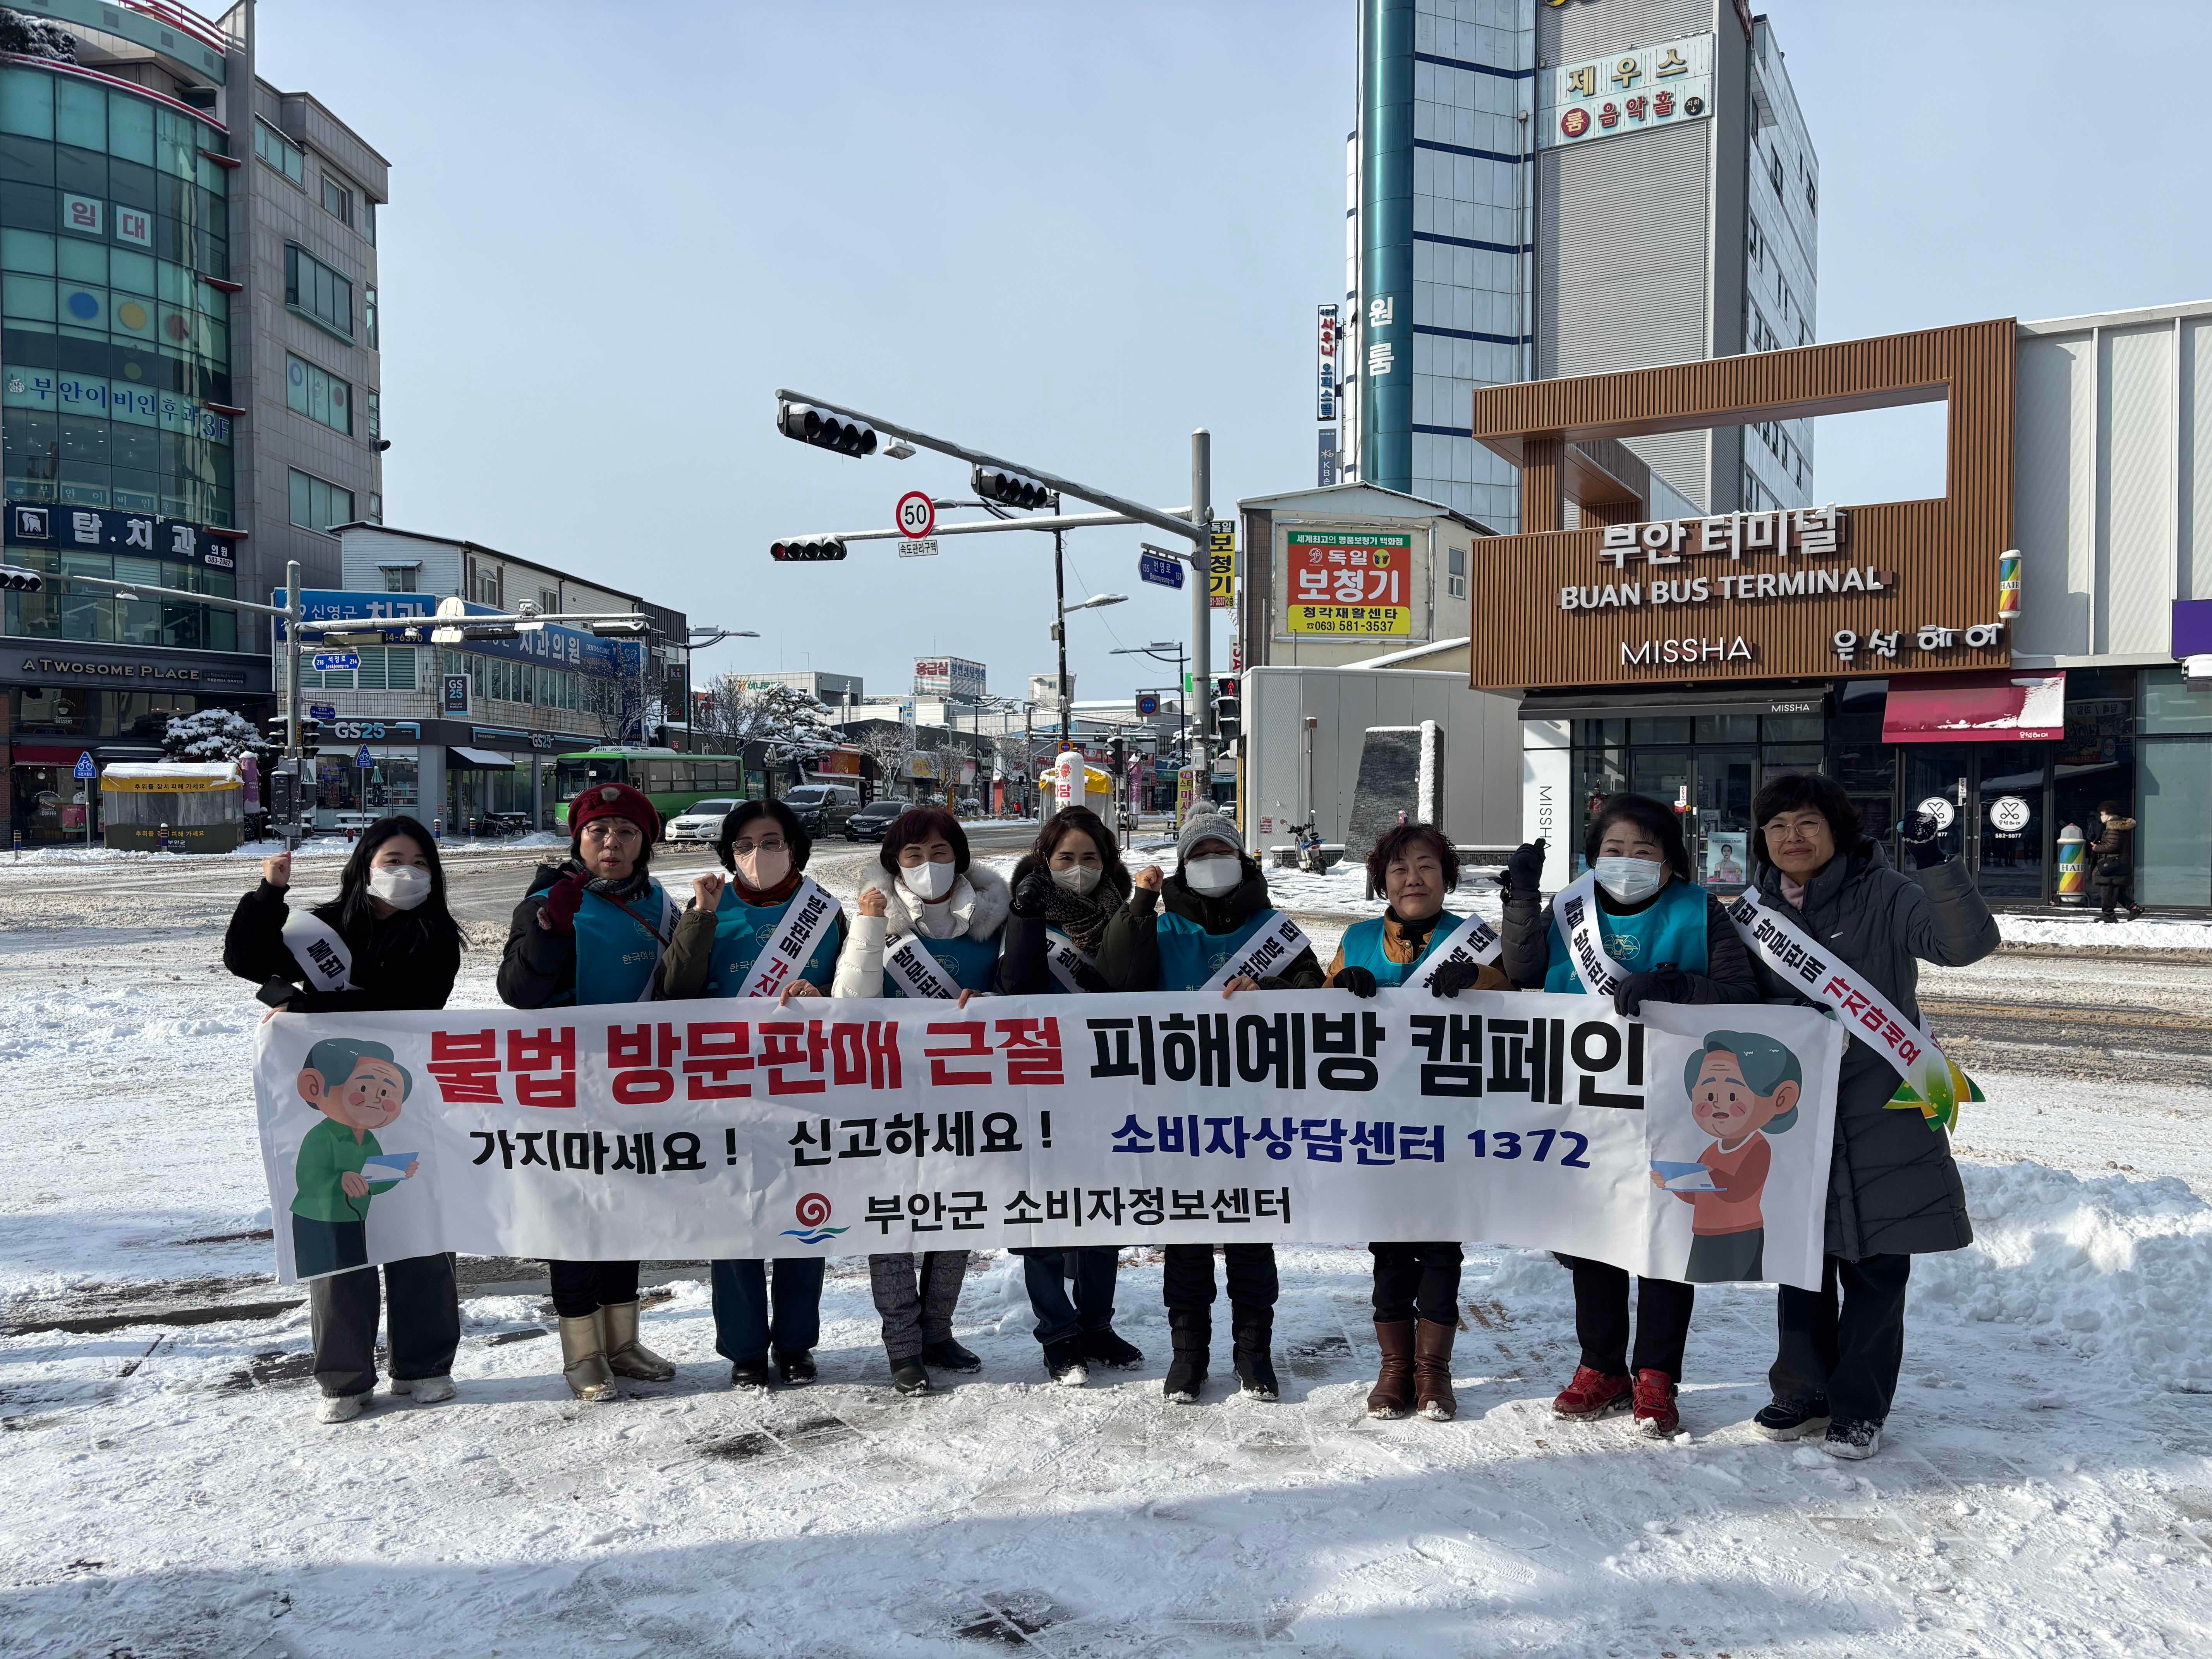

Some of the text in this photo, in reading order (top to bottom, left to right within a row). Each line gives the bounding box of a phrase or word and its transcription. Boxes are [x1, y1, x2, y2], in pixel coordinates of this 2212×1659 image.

[1567, 48, 1687, 97] 제우스
[1565, 111, 1586, 133] 룸
[1598, 91, 1674, 128] 음악홀
[71, 201, 145, 240] 임대
[1321, 318, 1334, 357] 사우나
[1368, 296, 1395, 376] 원룸
[1321, 363, 1333, 416] 오피스텔
[30, 377, 229, 440] 부안이비인후과 3F
[905, 505, 927, 526] 50
[1297, 534, 1403, 546] 세계최고의 명품보청기 백화점
[1599, 502, 1837, 568] 부안 터미널
[211, 544, 228, 557] 의원
[899, 541, 937, 556] 속도관리구역
[1328, 550, 1367, 566] 독일
[1153, 560, 1171, 574] 번영로
[1297, 568, 1398, 603] 보청기
[1561, 566, 1884, 610] BUAN BUS TERMINAL
[2001, 581, 2020, 590] HAIR
[1303, 606, 1398, 620] 청각재활센타
[1339, 620, 1393, 632] 581-3537
[328, 655, 346, 663] 석정로
[519, 629, 580, 665] 치과의원
[1621, 635, 1752, 665] MISSHA
[23, 659, 199, 680] A TWOSOME PLACE
[916, 661, 948, 676] 응급실
[448, 679, 464, 689] GS
[449, 689, 464, 699] 25
[1772, 703, 1810, 712] MISSHA
[335, 721, 386, 738] GS25
[532, 734, 552, 749] GS25
[749, 957, 789, 998] 가지
[1752, 918, 1827, 984] 방문판매
[1822, 975, 1922, 1066] 가지마세요
[427, 1012, 1644, 1110] 불법 방문판매 근절 피해예방 캠페인
[470, 1128, 706, 1175] 가지마세요
[788, 1110, 1022, 1167] 신고하세요
[1111, 1111, 1445, 1165] 소비자상담센터
[1467, 1128, 1590, 1169] 1372
[865, 1186, 1291, 1234] 부안군 소비자정보센터
